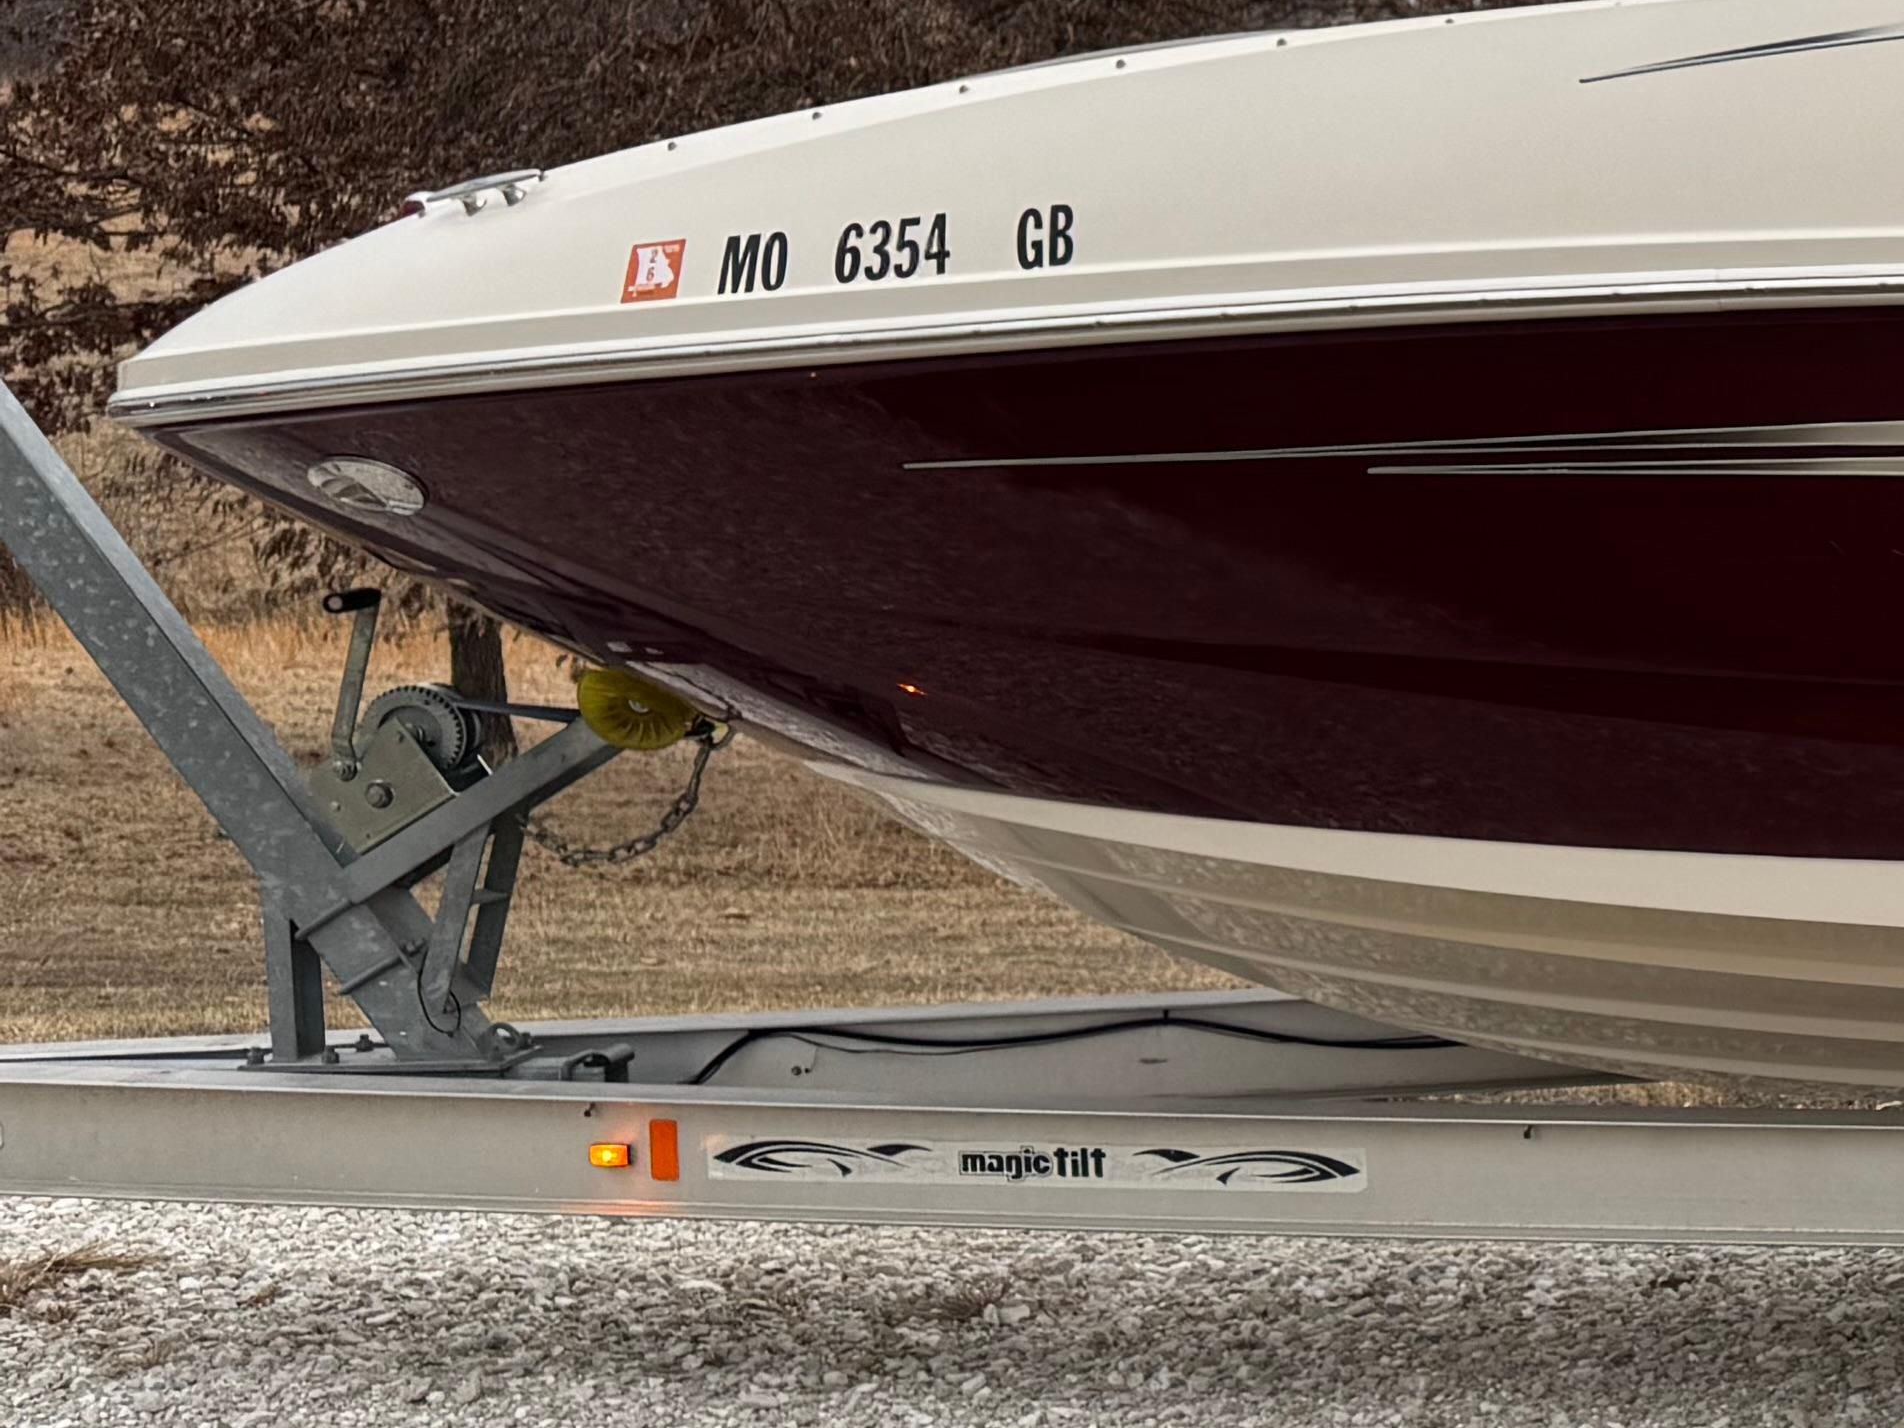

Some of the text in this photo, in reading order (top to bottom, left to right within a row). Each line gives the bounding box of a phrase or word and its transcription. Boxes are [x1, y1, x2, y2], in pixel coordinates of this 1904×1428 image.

[717, 204, 1074, 294] MO 6354 GB
